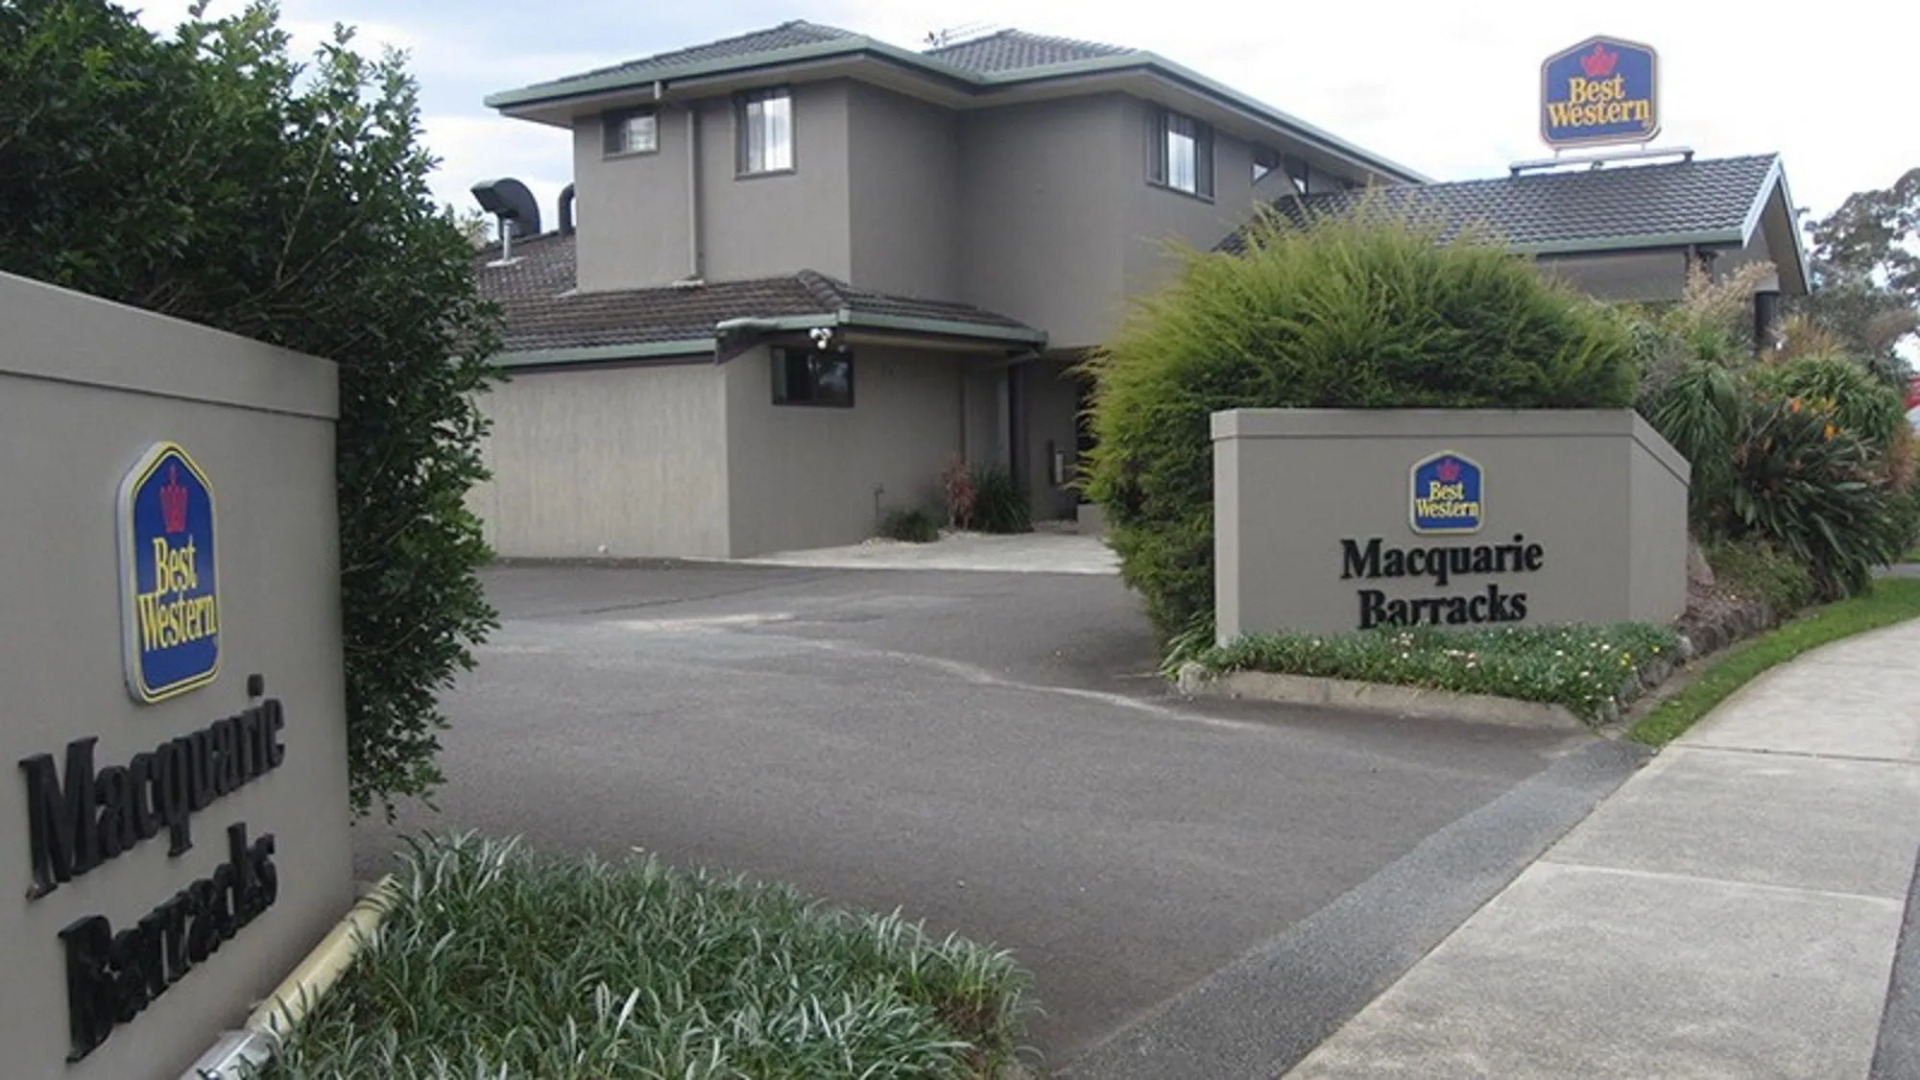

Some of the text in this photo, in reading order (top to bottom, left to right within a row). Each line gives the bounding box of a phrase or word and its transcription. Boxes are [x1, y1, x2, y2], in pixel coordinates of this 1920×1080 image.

[1569, 73, 1625, 103] Best
[1547, 99, 1649, 127] Western
[1416, 498, 1480, 518] Western
[1429, 481, 1465, 501] Best
[152, 535, 198, 594] Best
[1340, 534, 1544, 586] Macquarie
[137, 593, 217, 652] Western
[1357, 584, 1528, 630] Barracks
[19, 674, 286, 901] Macquarie
[58, 822, 279, 1063] Barracks
